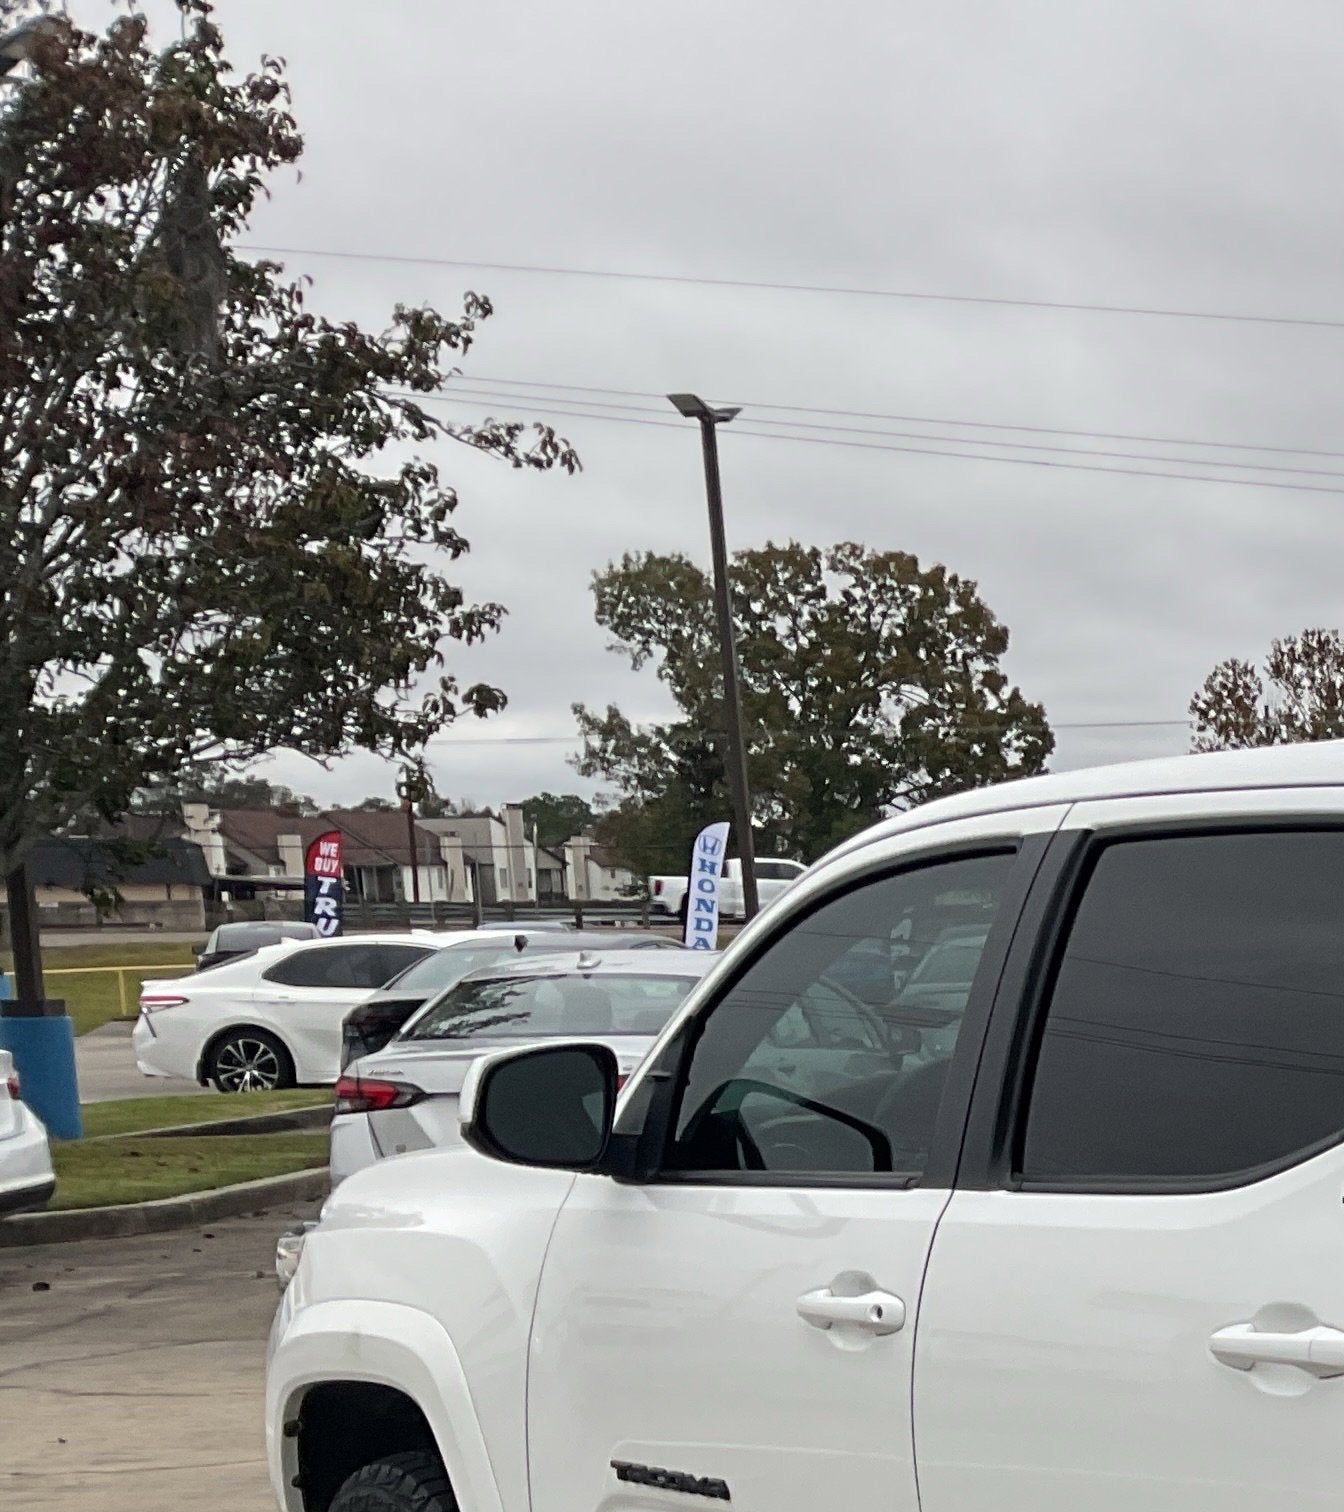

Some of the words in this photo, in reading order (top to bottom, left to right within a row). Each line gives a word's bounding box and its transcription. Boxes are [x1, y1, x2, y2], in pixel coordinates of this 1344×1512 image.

[319, 841, 339, 858] WE
[314, 857, 339, 873] BUY
[693, 858, 718, 950] HONDA
[609, 1459, 731, 1501] TACOMA
